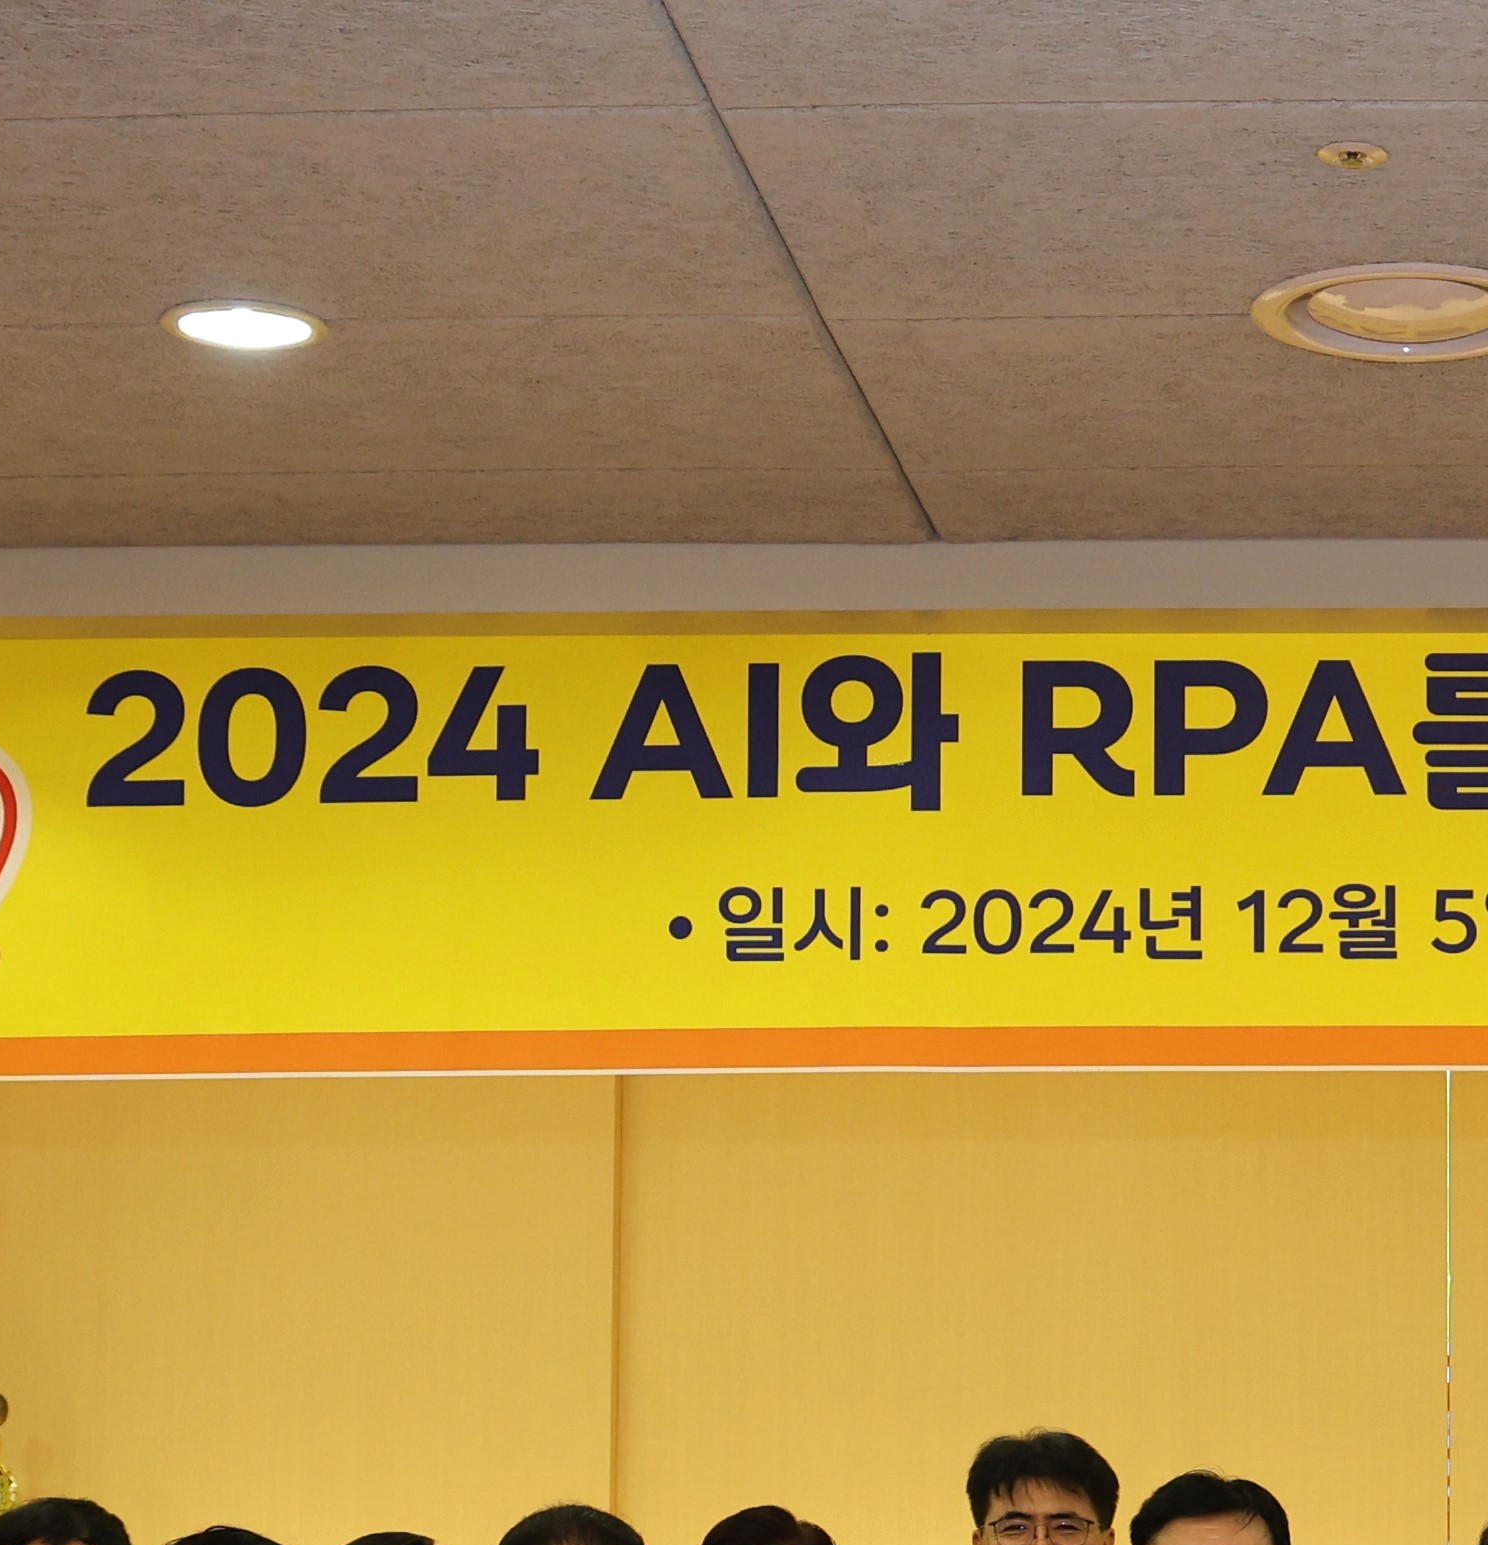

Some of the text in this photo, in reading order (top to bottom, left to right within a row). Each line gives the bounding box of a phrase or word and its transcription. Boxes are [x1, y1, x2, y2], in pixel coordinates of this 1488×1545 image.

[87, 666, 539, 807] 2024
[590, 652, 959, 811] AI와
[719, 887, 888, 961] 일시:
[921, 886, 1202, 959] 2024년
[1237, 884, 1397, 959] 12월
